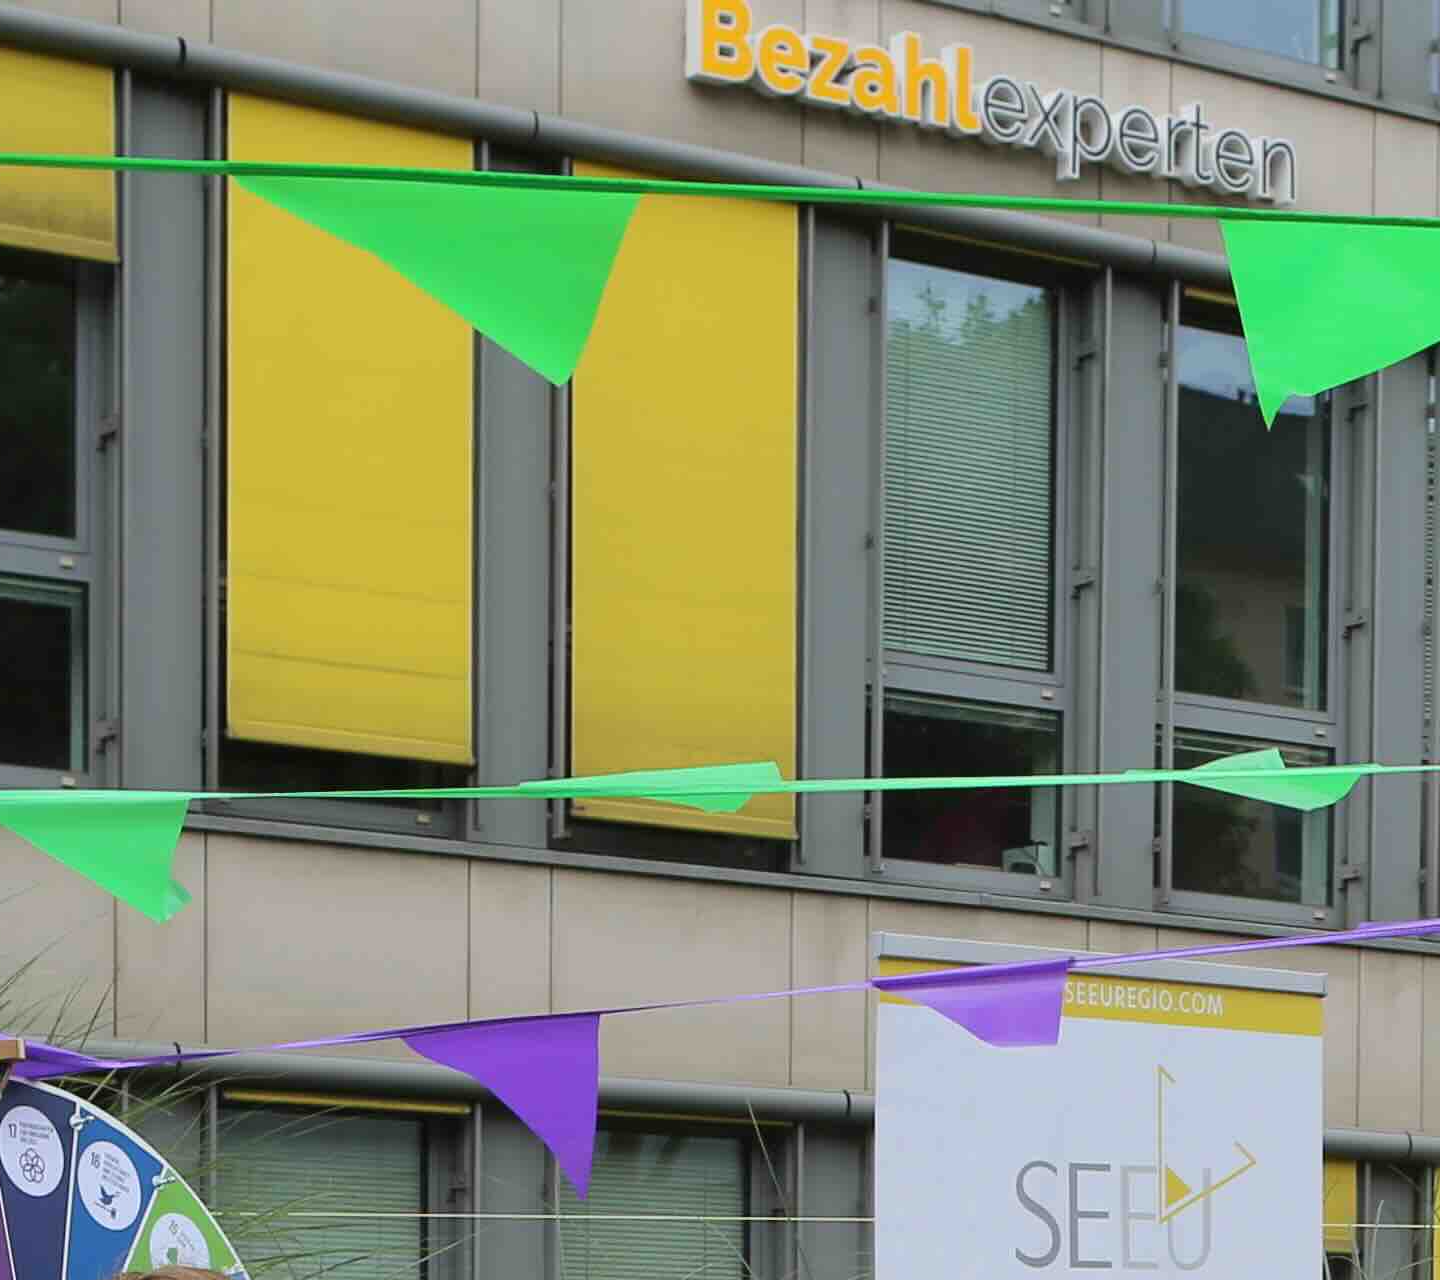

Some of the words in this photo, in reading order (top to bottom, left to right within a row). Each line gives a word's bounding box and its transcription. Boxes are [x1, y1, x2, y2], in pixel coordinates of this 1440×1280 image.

[688, 0, 1296, 203] Bezahlexperten
[1064, 982, 1225, 1016] SEEUREGIO.COM
[1014, 1160, 1213, 1271] SEEU
